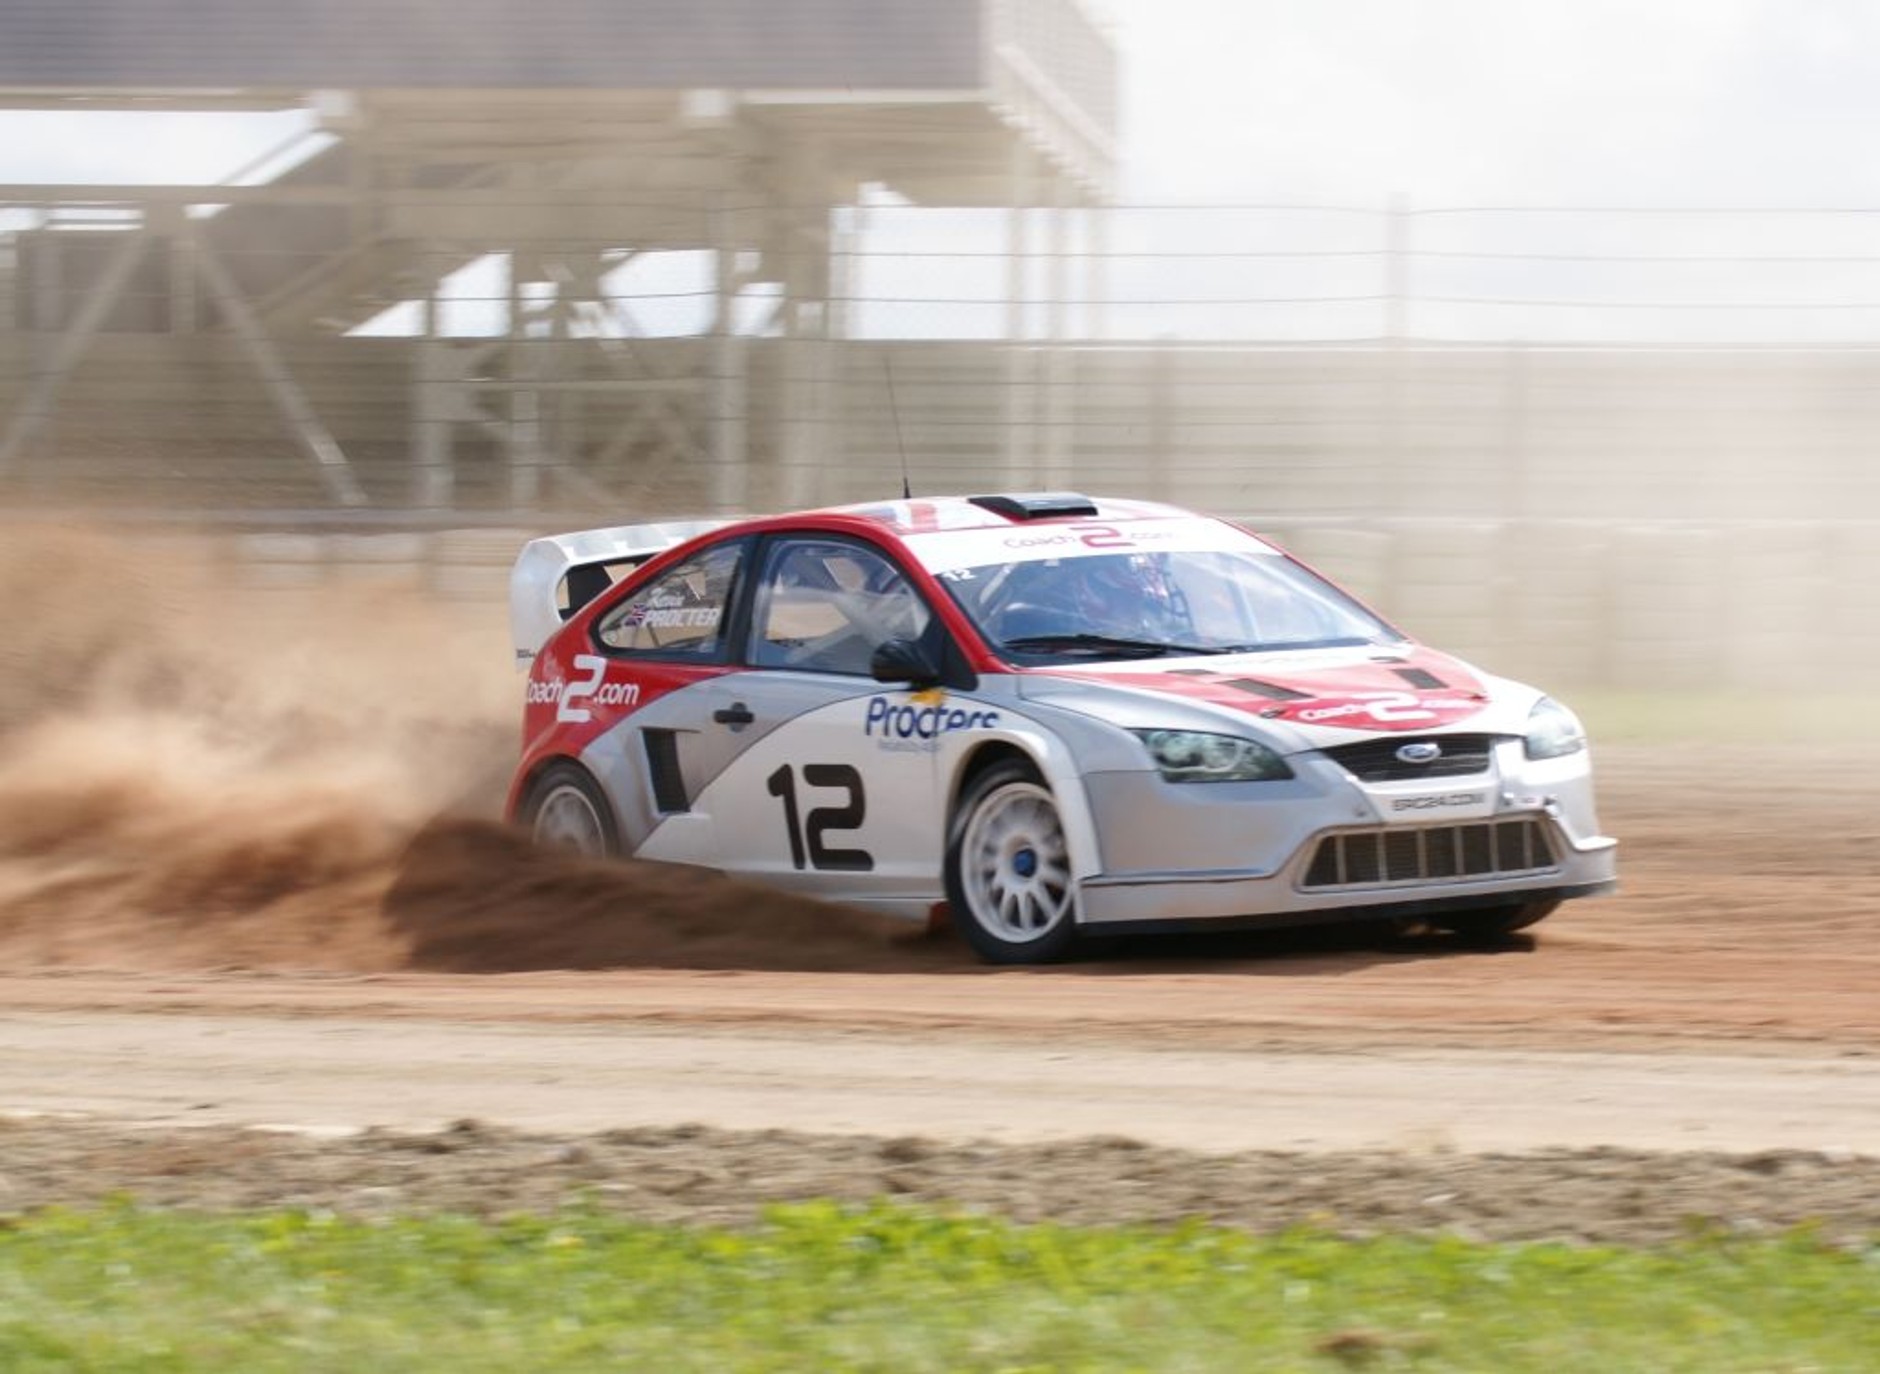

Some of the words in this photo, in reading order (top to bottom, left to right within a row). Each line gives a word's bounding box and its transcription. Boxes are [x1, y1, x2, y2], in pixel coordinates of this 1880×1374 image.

[641, 607, 721, 627] PROCTER
[864, 696, 998, 738] Procters
[767, 763, 874, 872] 12
